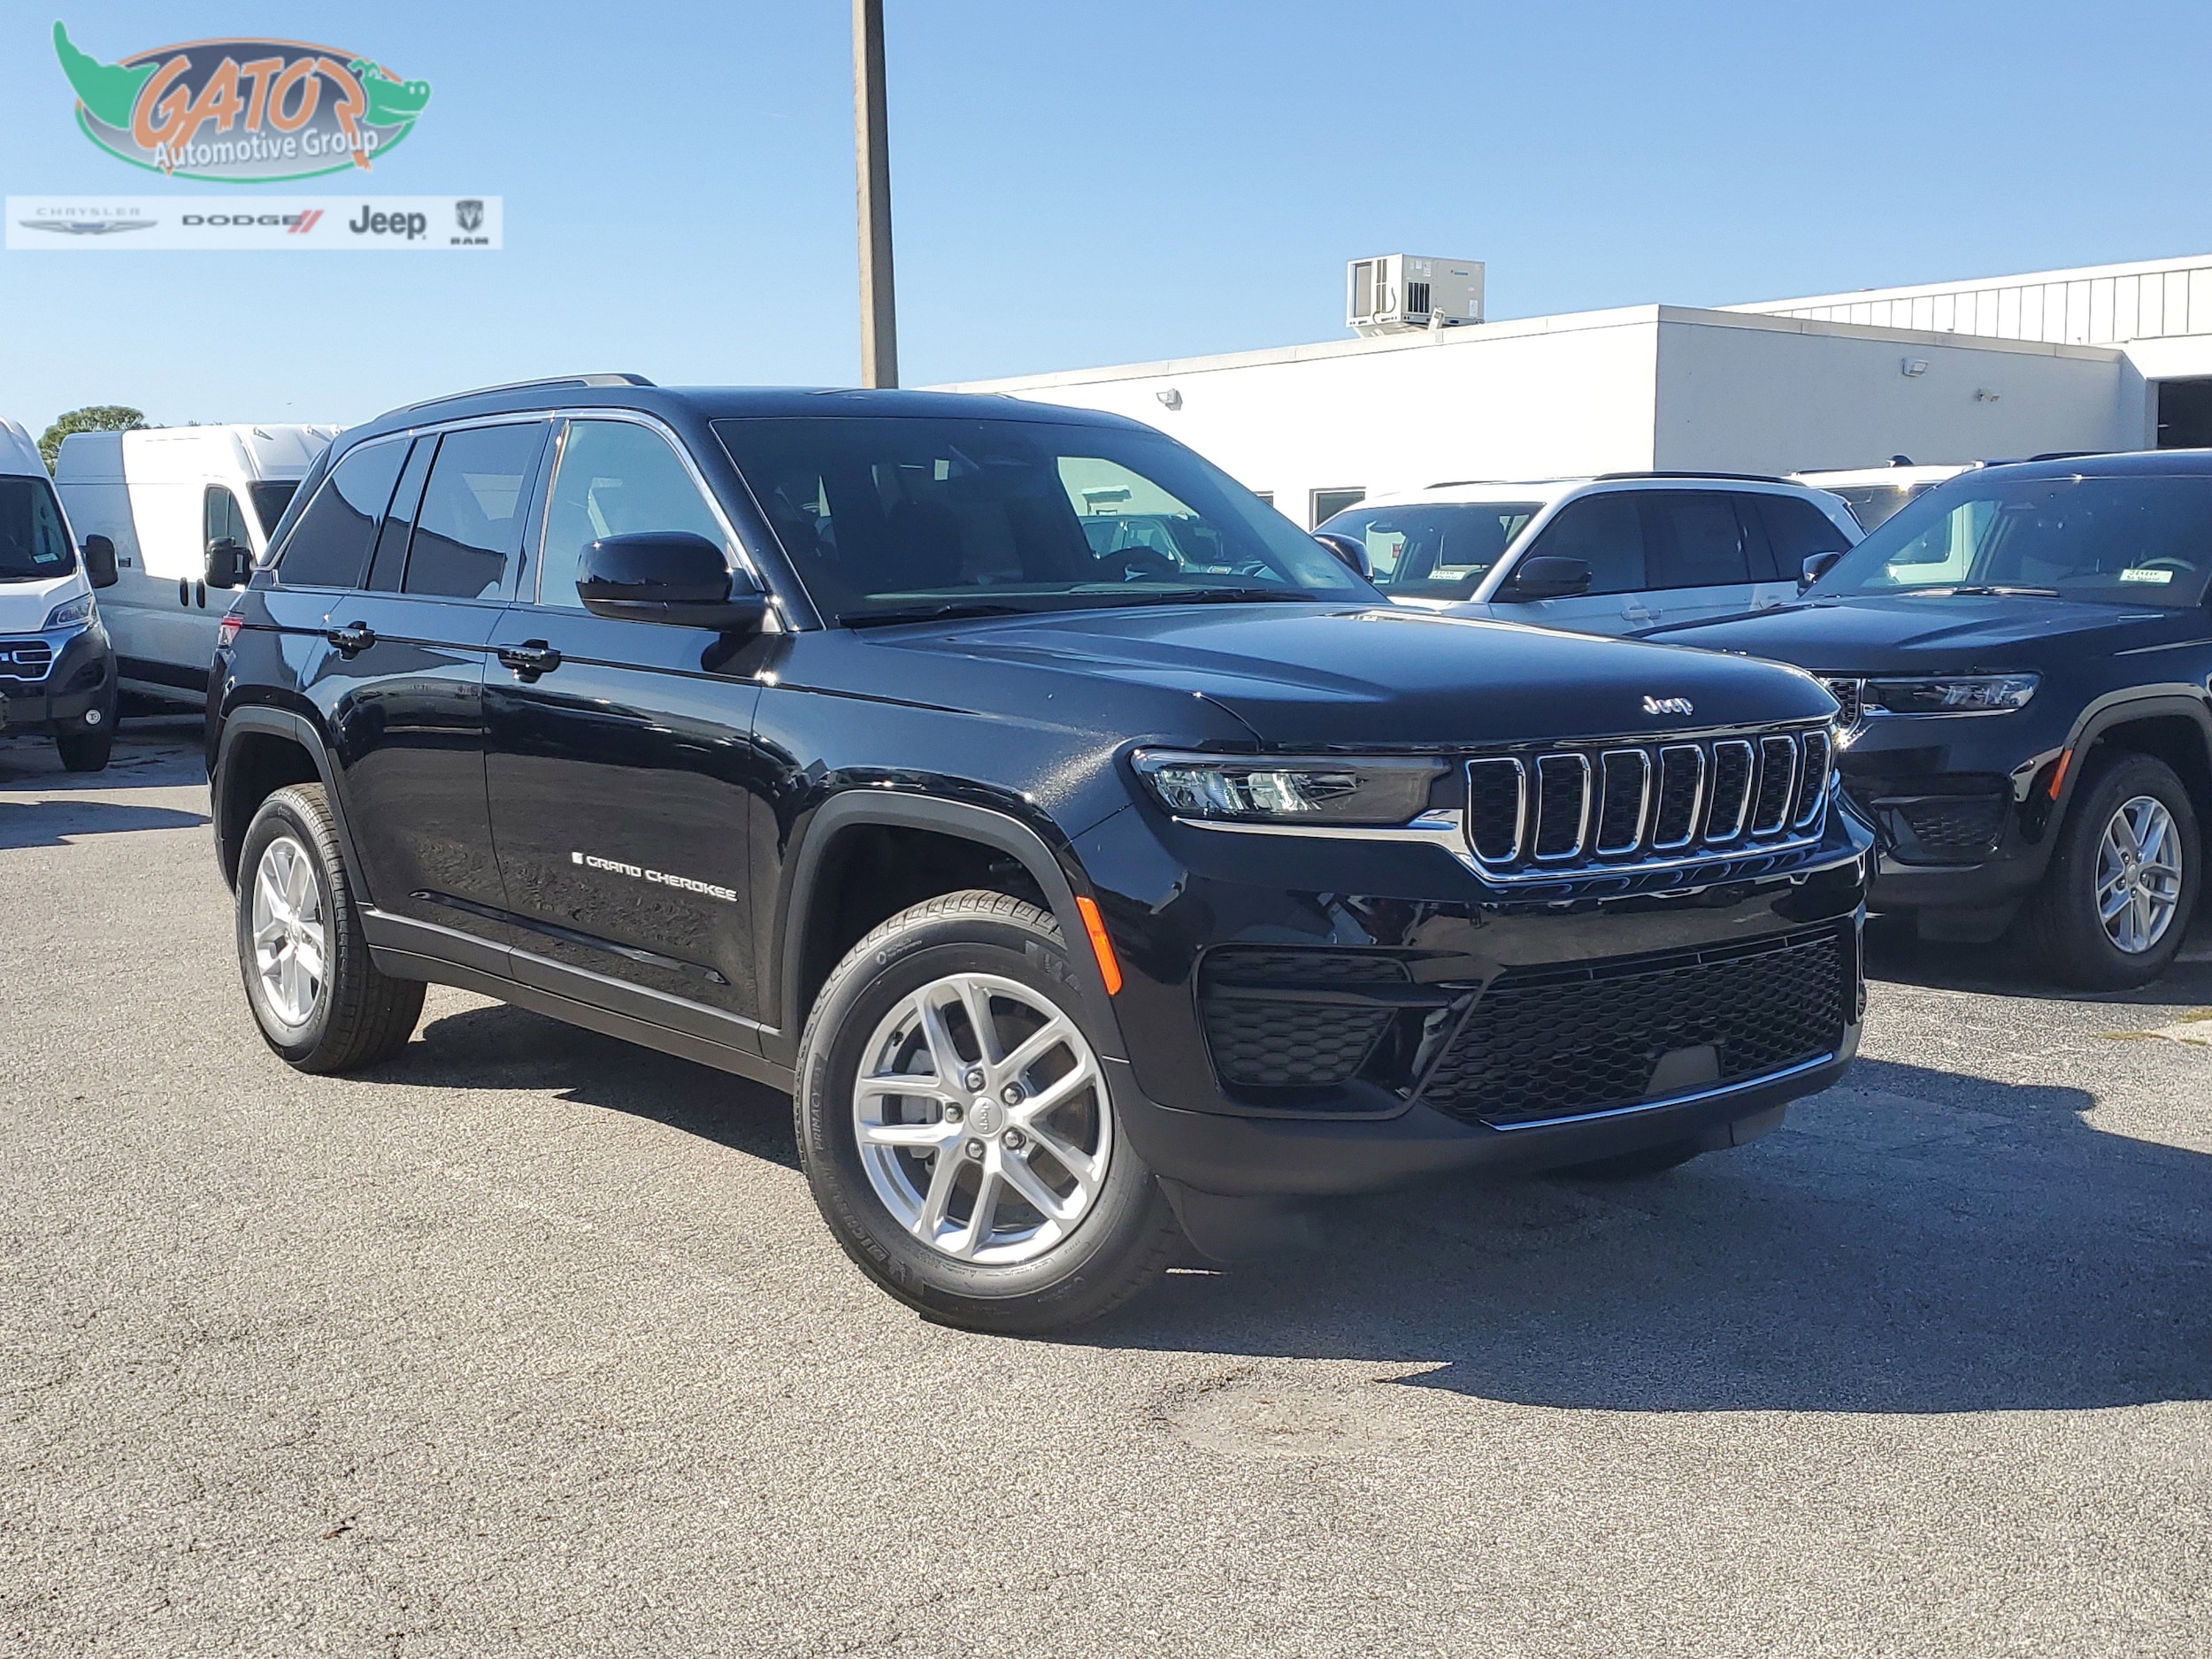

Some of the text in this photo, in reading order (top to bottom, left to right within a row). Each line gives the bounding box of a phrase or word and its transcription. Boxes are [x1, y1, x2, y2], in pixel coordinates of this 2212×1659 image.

[1643, 695, 1694, 716] Jeep
[586, 855, 739, 902] GRAND CHEROKEE
